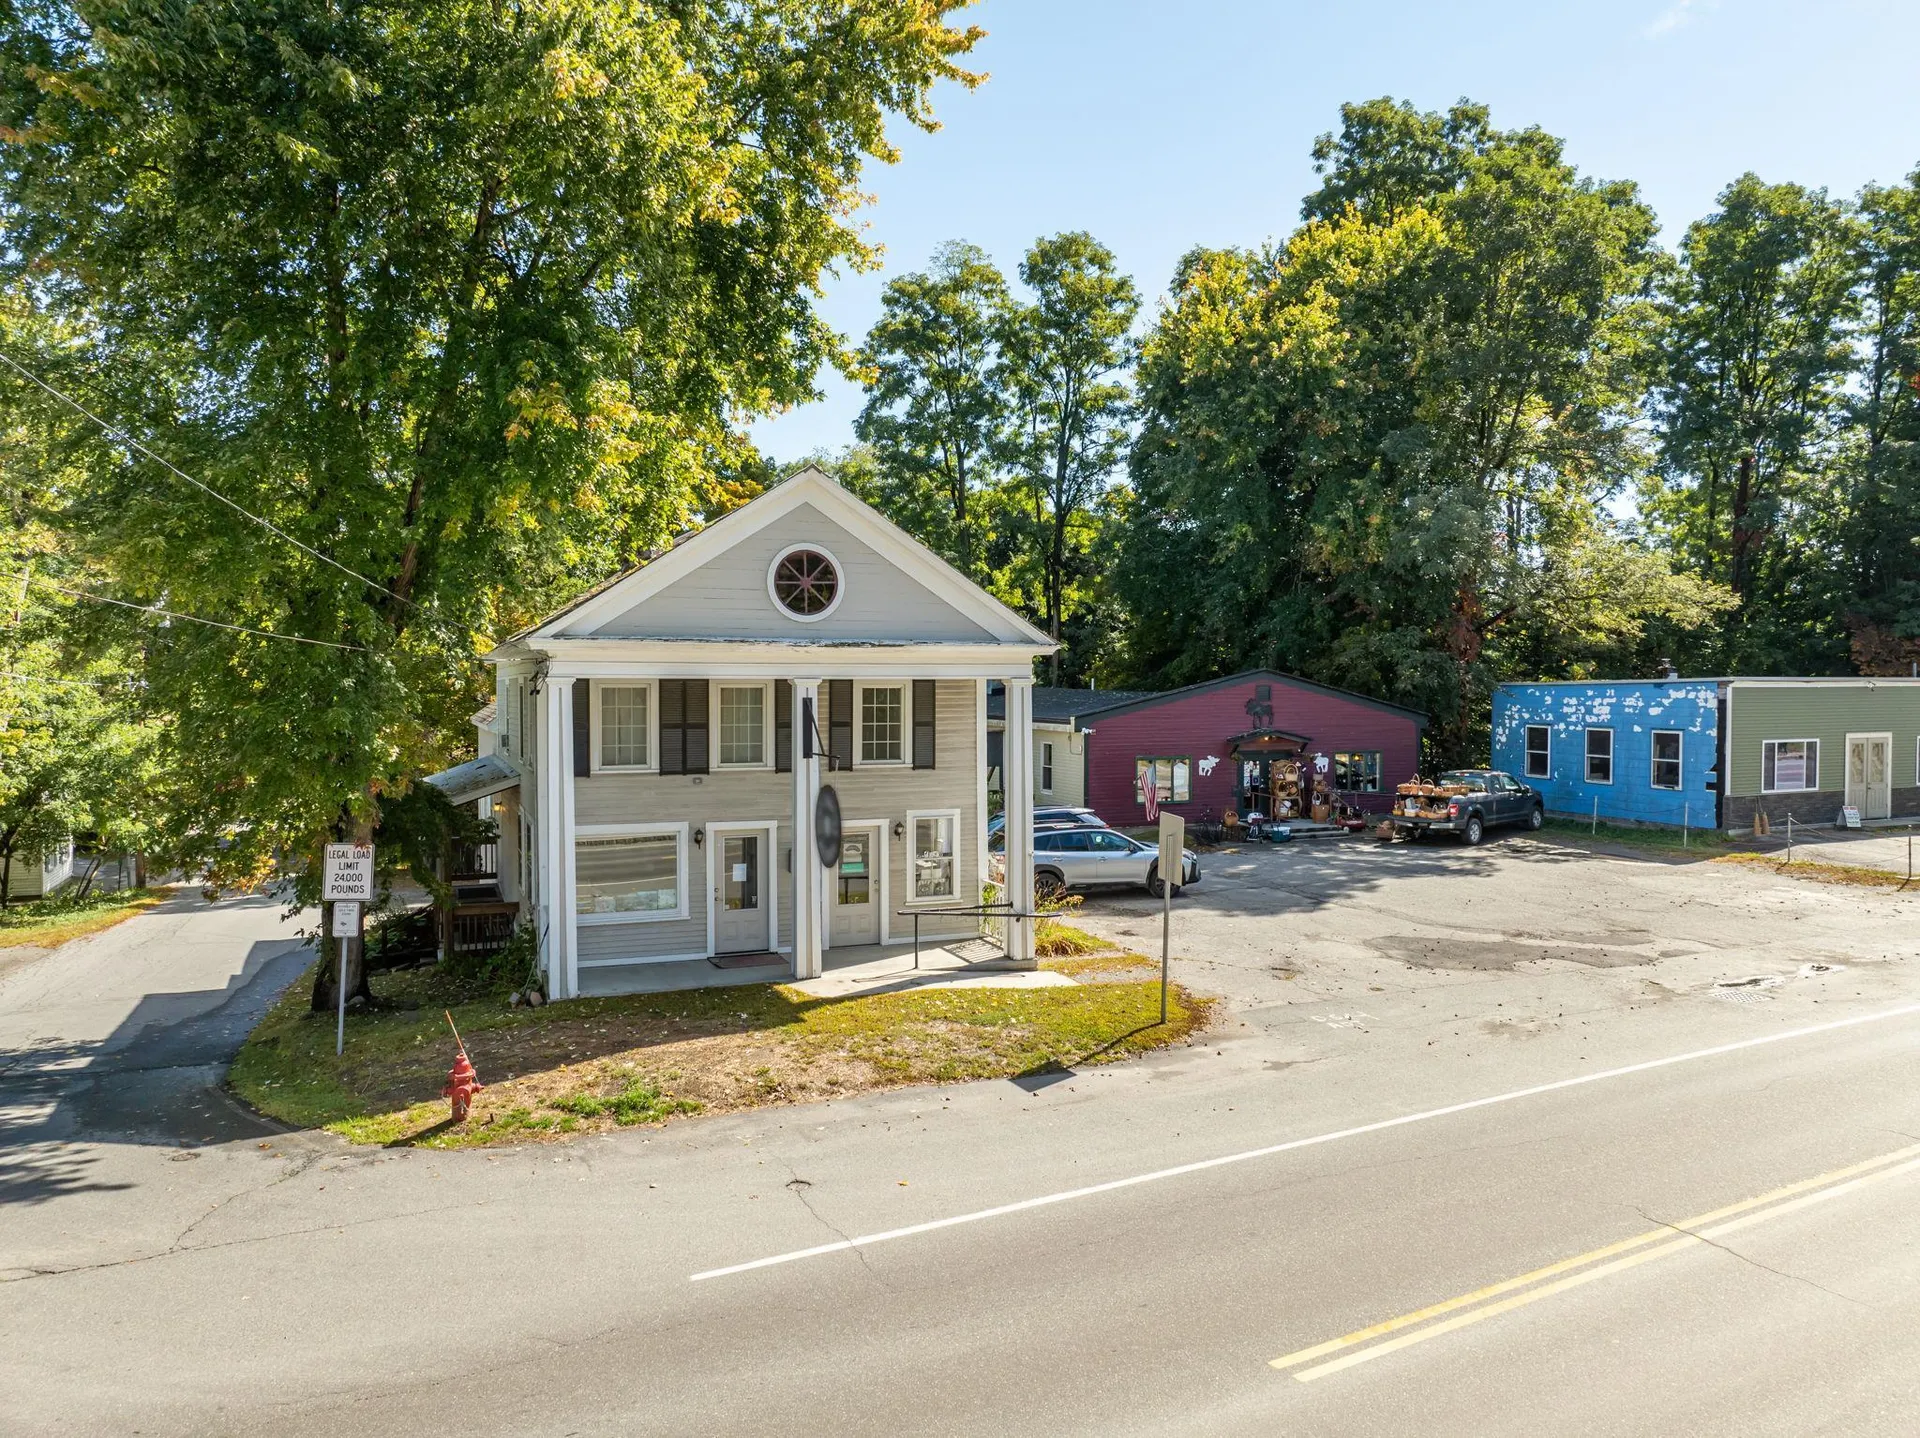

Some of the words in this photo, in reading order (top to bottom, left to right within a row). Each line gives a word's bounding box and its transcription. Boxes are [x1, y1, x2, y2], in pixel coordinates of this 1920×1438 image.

[328, 850, 350, 860] LEGAL
[352, 850, 371, 860] LOAD
[338, 861, 360, 871] LIMIT
[331, 885, 365, 894] POUNDS
